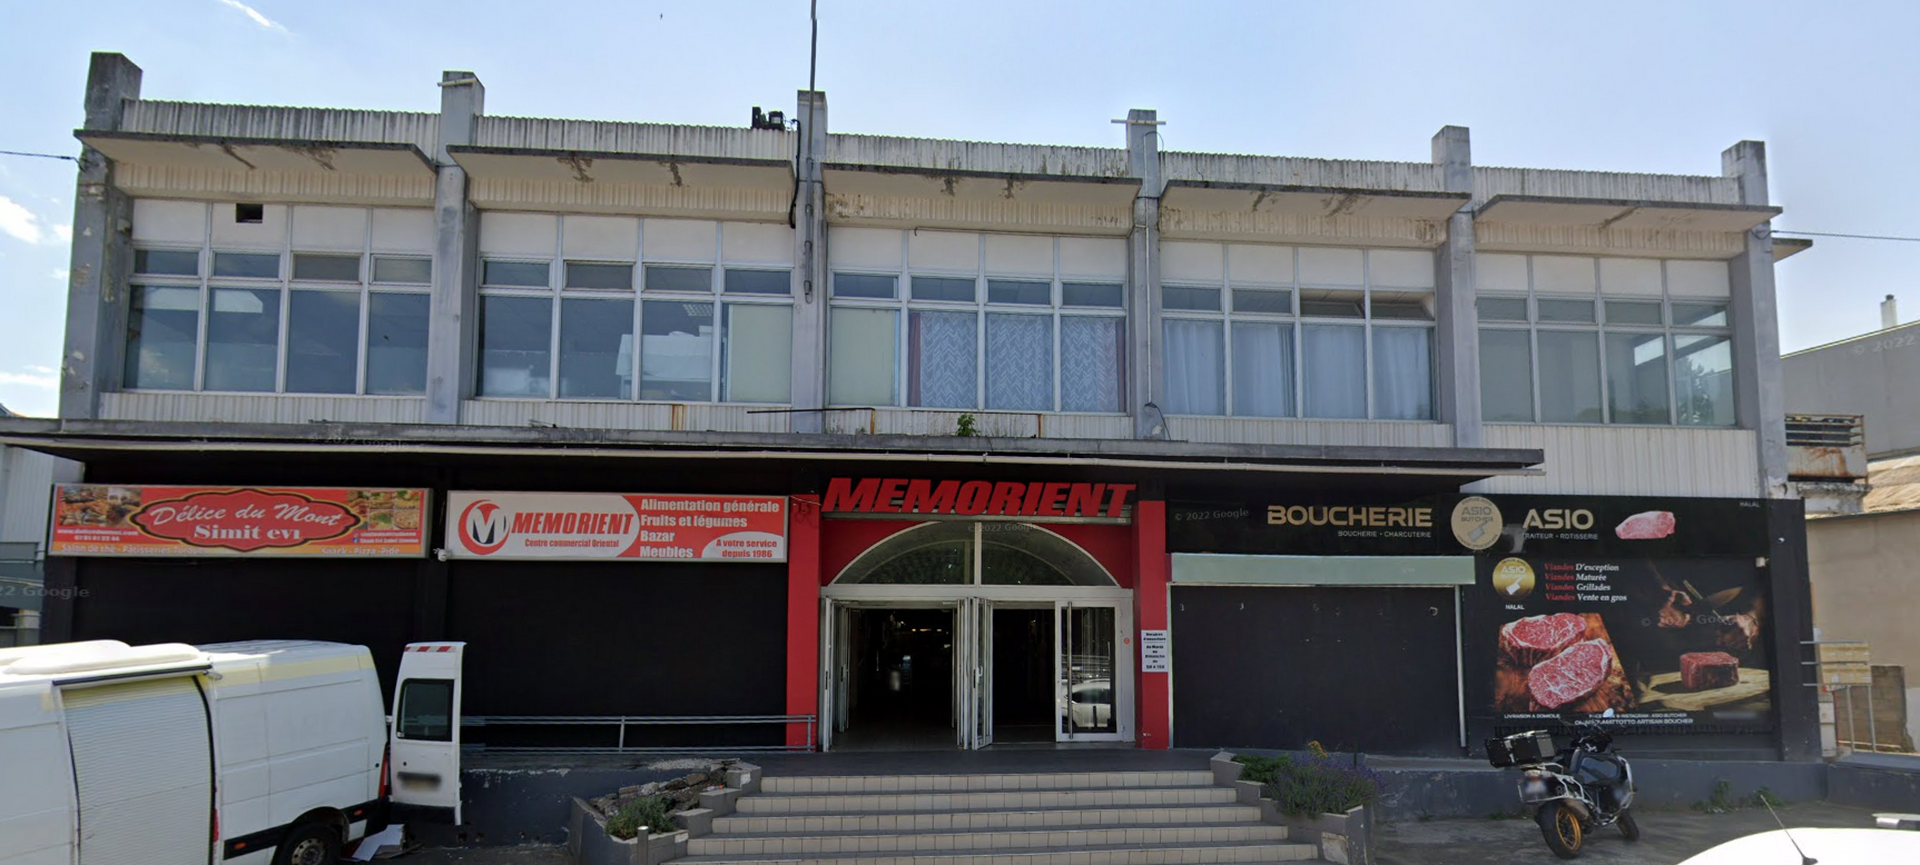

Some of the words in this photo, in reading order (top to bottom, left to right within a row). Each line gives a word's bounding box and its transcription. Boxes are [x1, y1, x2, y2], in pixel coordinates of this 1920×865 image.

[821, 477, 1137, 518] MEMORIENT
[641, 498, 721, 511] Alimentation
[723, 500, 780, 513] générale
[1461, 506, 1493, 516] ASIO
[150, 504, 227, 526] Délice
[235, 503, 266, 519] du
[273, 503, 343, 526] Mont
[1267, 505, 1433, 527] BOUCHERIE
[1522, 508, 1594, 530] ASIO
[511, 512, 634, 535] MEMORIENT
[641, 514, 677, 527] Fruits
[679, 515, 692, 527] et
[694, 515, 748, 528] légumes
[194, 524, 262, 540] Simit
[640, 530, 676, 542] Bazar
[525, 538, 548, 547] Centre
[549, 539, 591, 548] commercial
[592, 539, 620, 548] Oriental
[723, 539, 746, 547] votre
[746, 539, 777, 548] service
[640, 546, 694, 558] Meubles
[722, 549, 751, 559] depuis
[752, 550, 773, 558] 1986
[1501, 565, 1527, 574] ASIO
[1544, 563, 1575, 571] Viandes
[1575, 563, 1620, 572] D'exception
[1575, 573, 1607, 581] Maturée
[1545, 583, 1575, 591] Viandes
[1576, 583, 1611, 591] Grillades
[1545, 593, 1576, 601] Viandes
[1576, 593, 1599, 601] Vente
[1610, 595, 1628, 603] gros
